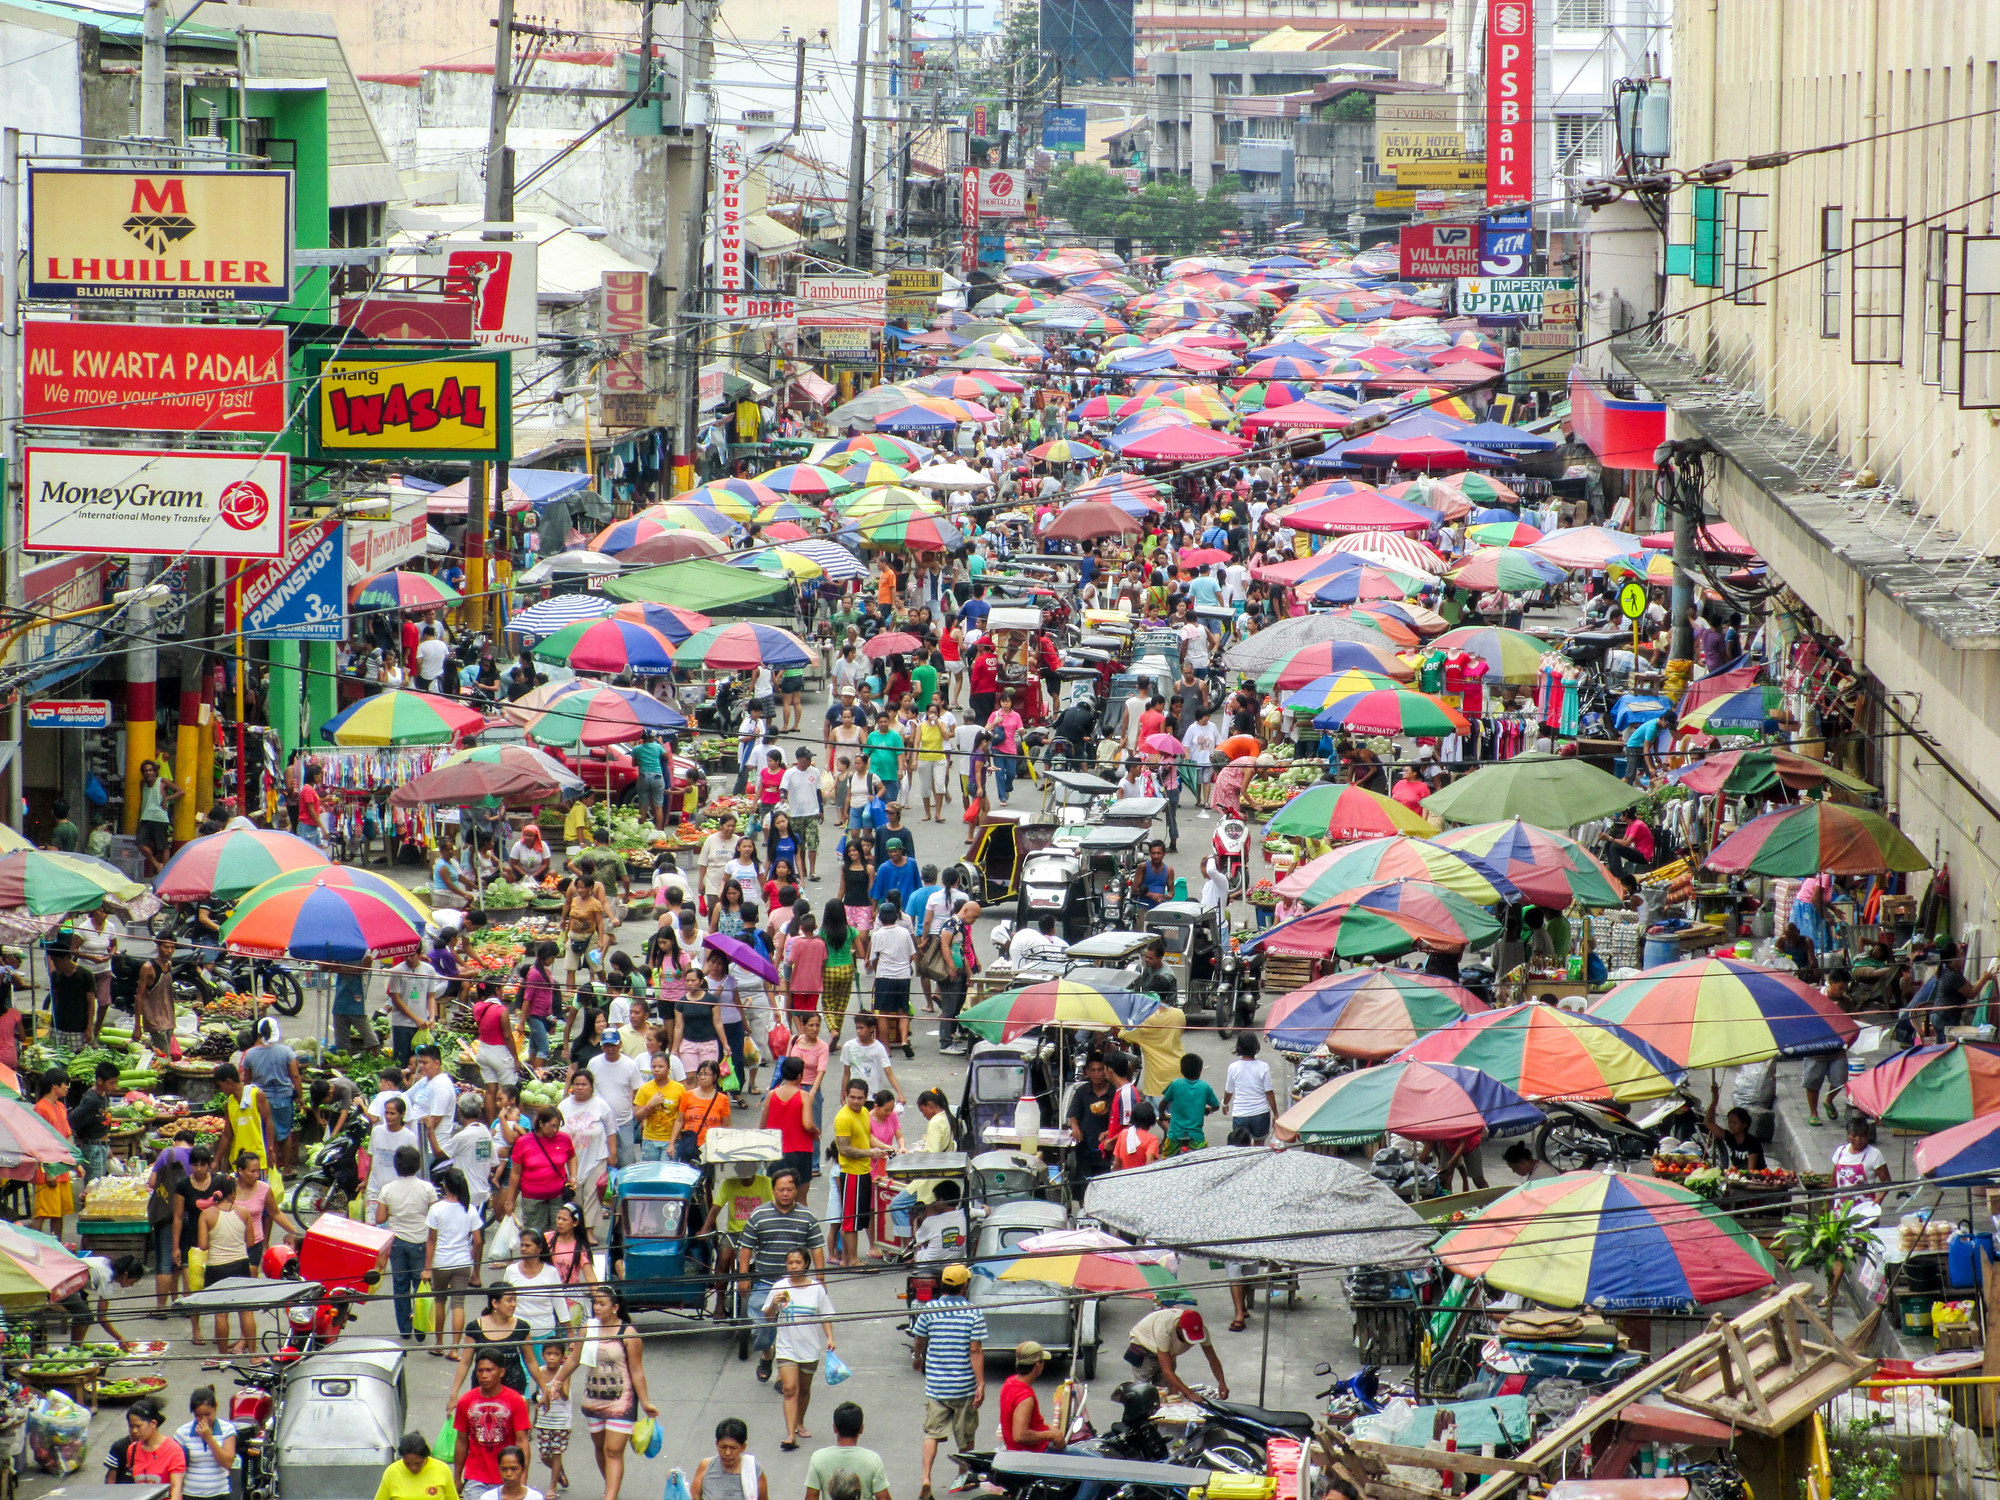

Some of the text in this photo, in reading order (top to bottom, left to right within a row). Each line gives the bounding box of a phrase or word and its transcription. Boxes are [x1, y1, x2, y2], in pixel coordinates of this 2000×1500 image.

[1500, 45, 1519, 185] PSBank
[1386, 136, 1459, 146] NEW J. HOTEL
[1386, 148, 1460, 157] ENTRANCE
[131, 179, 188, 214] M
[983, 198, 1021, 206] HORTALEZA
[723, 169, 740, 316] TRUSTWORTHY
[1437, 229, 1469, 245] VP
[1494, 234, 1525, 254] ATM
[1410, 248, 1479, 261] VILLARIC
[48, 257, 271, 284] LHUILLIER
[1411, 262, 1479, 275] PAWNSHO
[76, 286, 235, 300] BLUMENTRITT BRANCH
[800, 281, 885, 304] Tambunting
[1495, 281, 1561, 291] IMPERIAL
[747, 301, 794, 318] DRUG
[1490, 294, 1543, 312] PAWN
[29, 349, 279, 382] ML KWARTA PADALA
[332, 368, 378, 384] Mang
[44, 383, 254, 410] We move your money fast!
[328, 376, 487, 436] INASAL
[40, 481, 203, 510] MoneyGram
[78, 510, 212, 524] International Money Transfer
[1333, 522, 1392, 531] MICROMATIC
[233, 526, 324, 617] MEGATREND
[249, 540, 335, 631] PAWNSHOP
[304, 593, 339, 623] 3%
[865, 619, 876, 637] 2
[58, 705, 105, 714] MEGATREND
[1356, 725, 1398, 736] MICROMATIC
[241, 946, 282, 957] MICROMATIC
[380, 943, 419, 956] MICROMATIC
[1277, 947, 1328, 958] MICROMATIC
[1321, 1131, 1378, 1144] MICROMATIC
[1610, 1296, 1684, 1308] MICROMATIC
